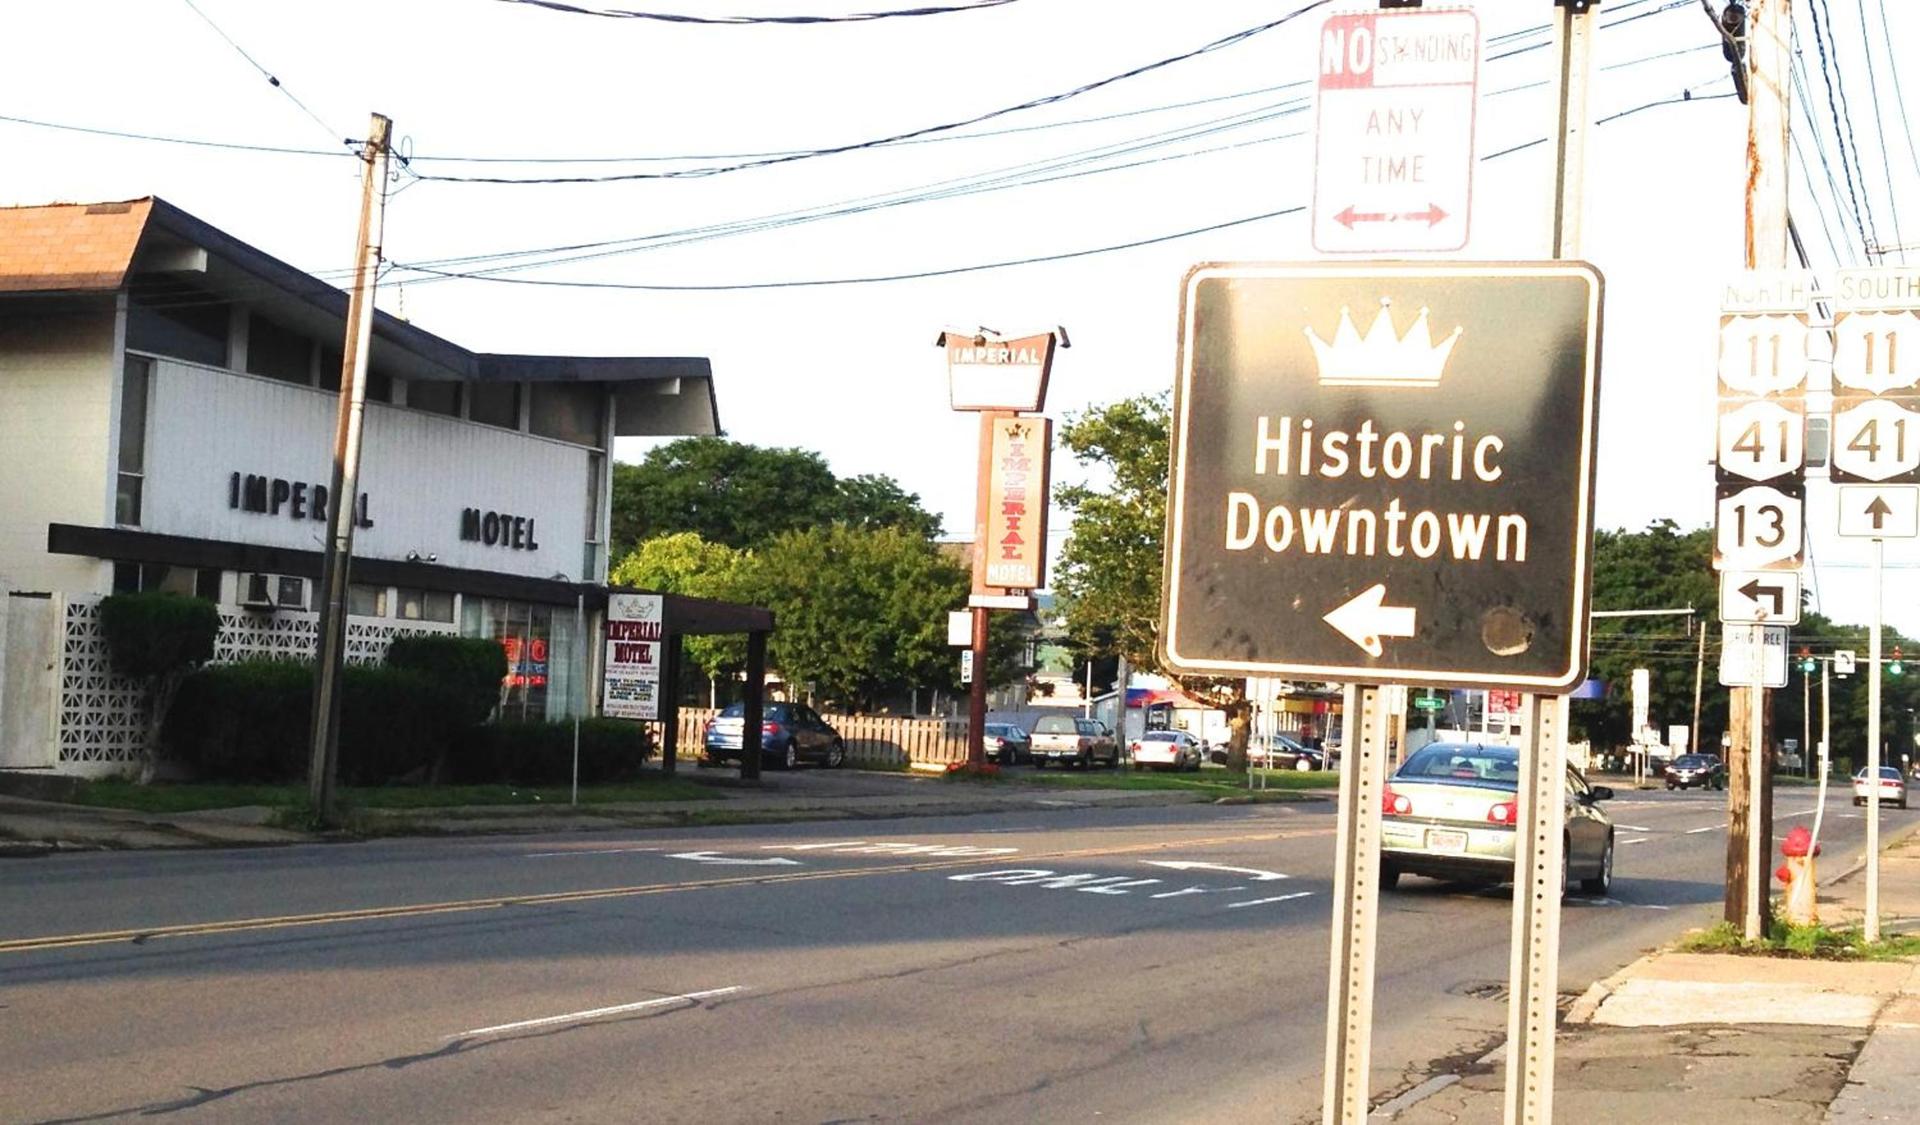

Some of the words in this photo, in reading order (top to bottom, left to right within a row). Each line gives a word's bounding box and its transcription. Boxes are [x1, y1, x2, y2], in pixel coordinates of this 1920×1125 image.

[1322, 26, 1372, 75] NO
[1379, 33, 1473, 65] STANDING
[1366, 108, 1424, 135] ANY
[1362, 155, 1425, 184] TIME
[1842, 275, 1920, 300] SOUTH
[954, 348, 1041, 364] IMPERIAL
[1749, 334, 1780, 376] 11
[1863, 331, 1897, 374] 11
[1254, 416, 1504, 482] Historic
[1731, 420, 1788, 462] 41
[1847, 419, 1905, 462] 41
[228, 471, 374, 528] IMPERL
[459, 507, 539, 551] MOTEL
[1000, 443, 1031, 559] IMPERIAL
[1225, 491, 1528, 562] Downtown
[1734, 504, 1784, 547] 13
[988, 564, 1034, 582] MOTEL
[604, 620, 661, 642] IMPERIAL
[1729, 632, 1753, 645] RUG
[614, 642, 652, 664] MOTEL
